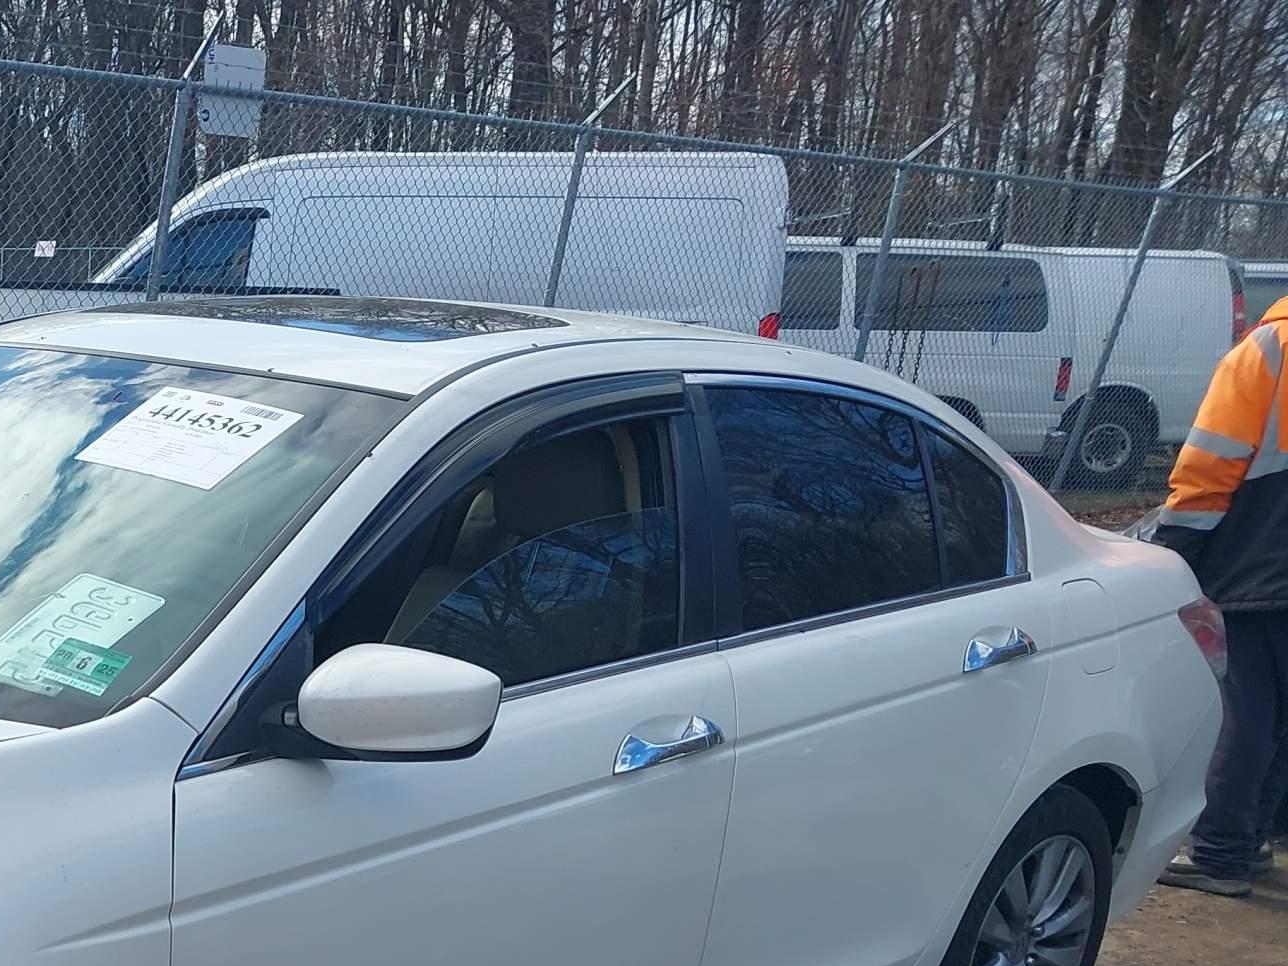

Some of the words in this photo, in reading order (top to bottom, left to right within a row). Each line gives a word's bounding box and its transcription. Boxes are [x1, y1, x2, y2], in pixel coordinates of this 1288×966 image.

[148, 404, 263, 438] 44145362
[76, 656, 92, 670] 6
[98, 663, 118, 677] 25
